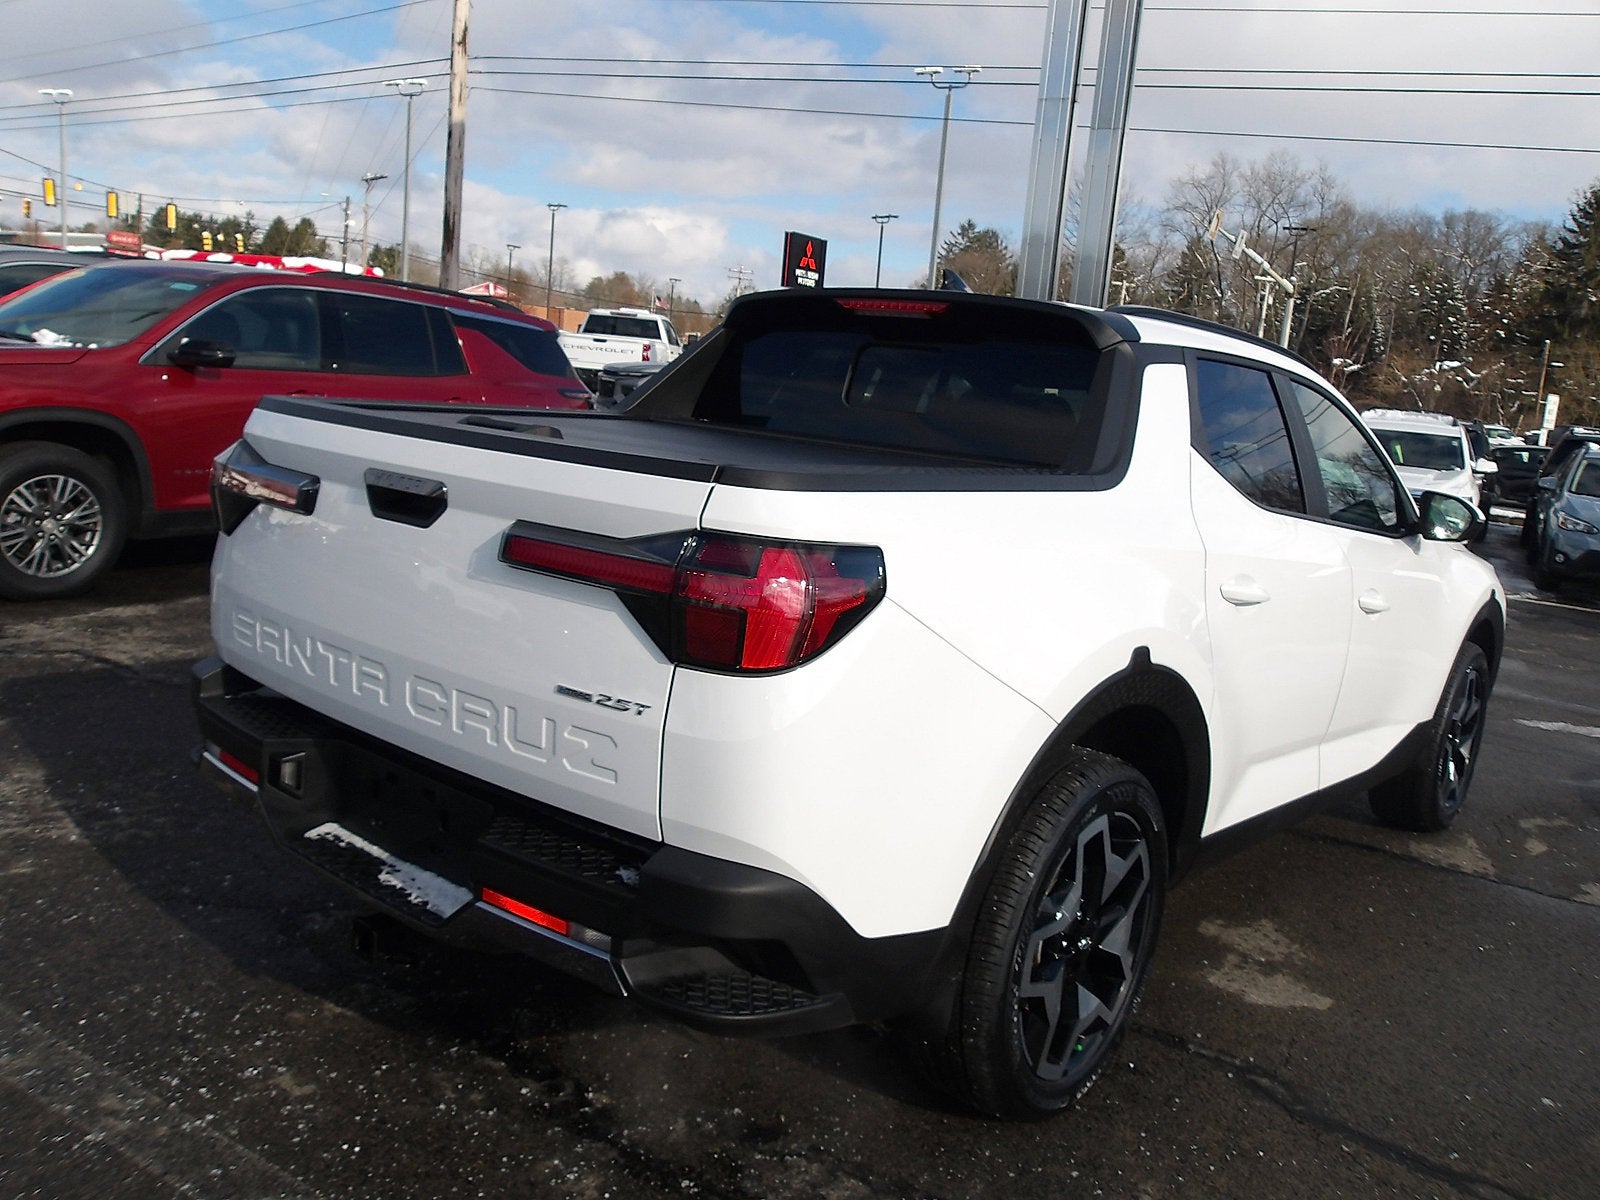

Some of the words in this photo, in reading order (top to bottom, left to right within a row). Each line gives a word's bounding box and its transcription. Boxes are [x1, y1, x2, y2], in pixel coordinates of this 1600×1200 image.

[562, 343, 635, 355] CHEVROLET
[231, 609, 391, 706] SANTA
[404, 673, 619, 785] CRUZ
